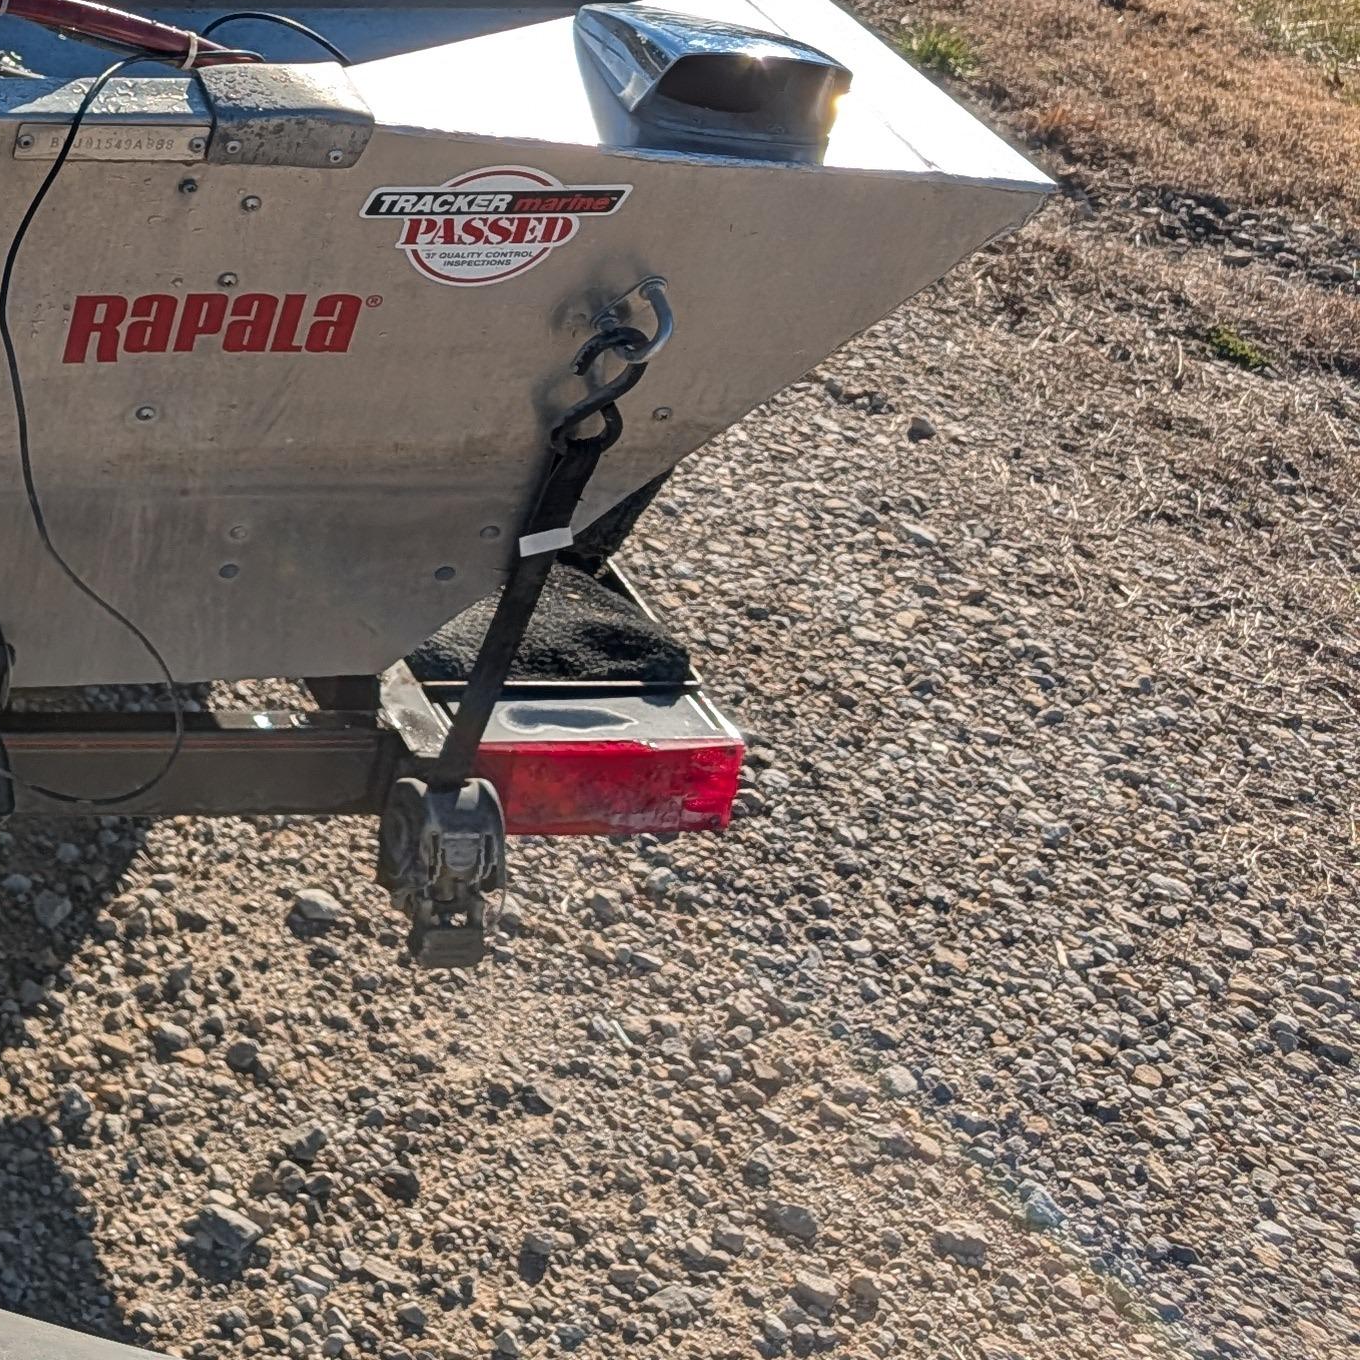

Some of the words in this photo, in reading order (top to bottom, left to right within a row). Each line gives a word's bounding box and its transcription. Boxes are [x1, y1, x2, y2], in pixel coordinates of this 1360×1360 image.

[379, 193, 513, 213] TRACKER
[400, 216, 574, 246] PASSED
[439, 251, 483, 259] QUALITY
[484, 249, 534, 259] CONTROL
[442, 258, 513, 267] INSPECTIONS
